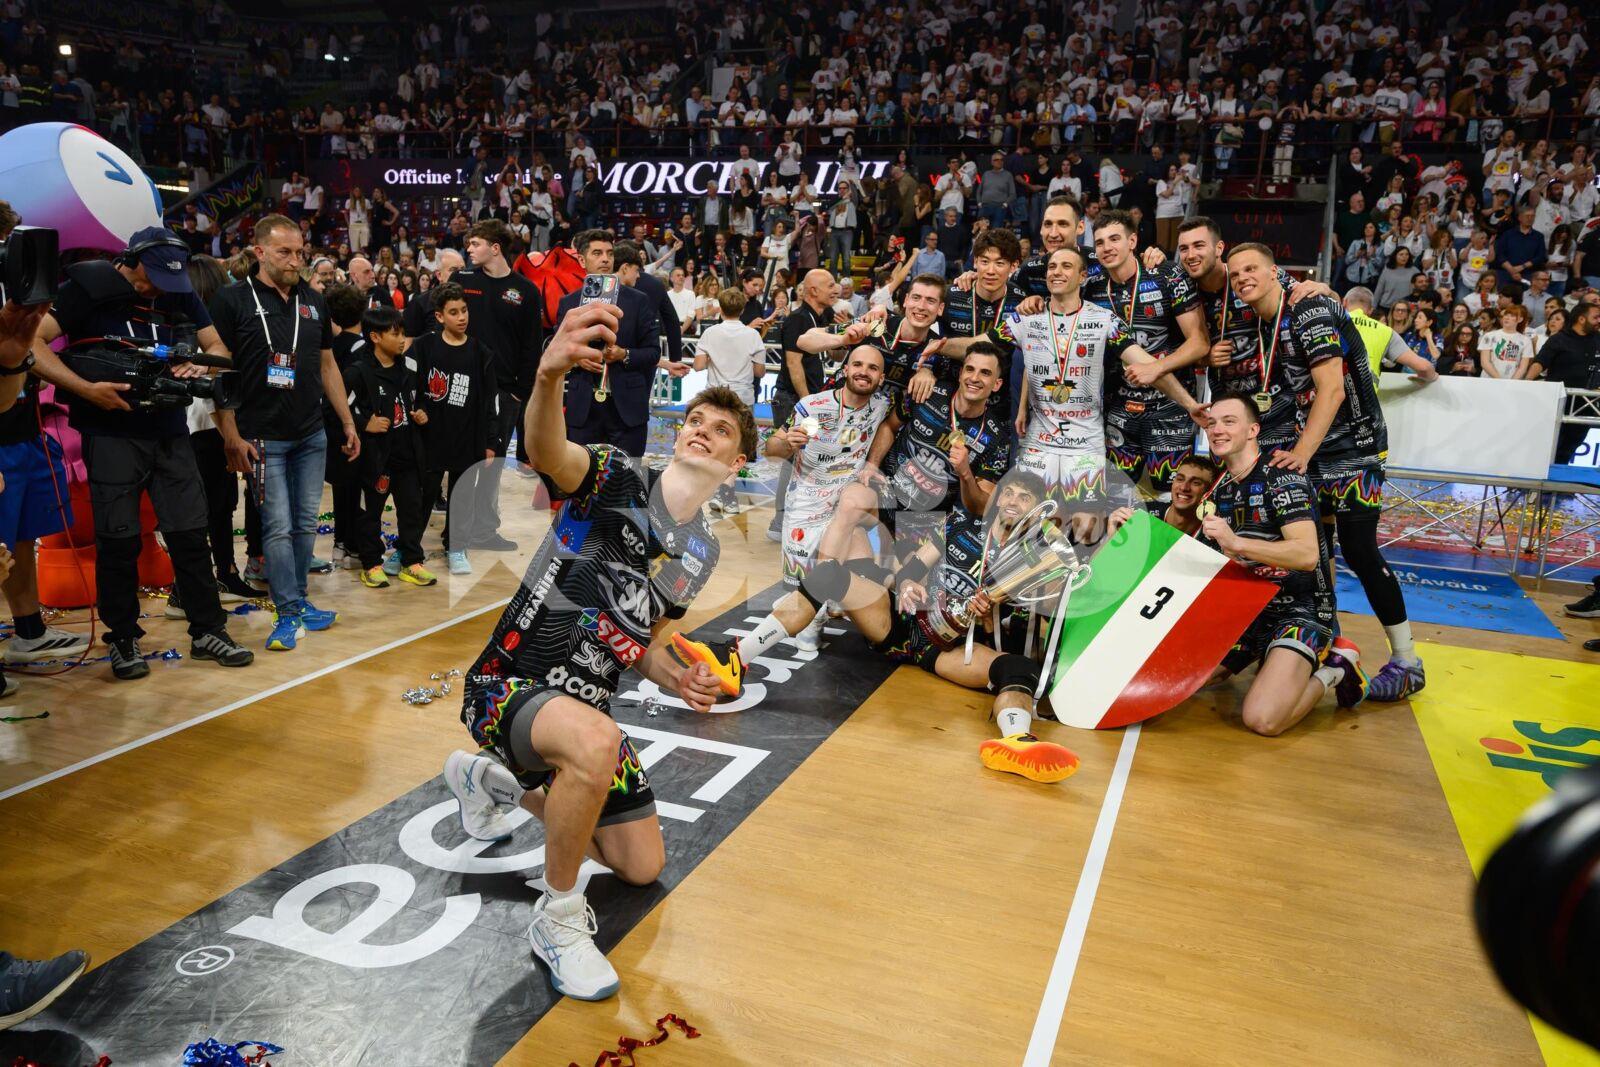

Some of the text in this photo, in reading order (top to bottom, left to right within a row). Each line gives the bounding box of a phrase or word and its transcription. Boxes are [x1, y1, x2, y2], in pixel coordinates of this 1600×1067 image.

[384, 168, 451, 185] Officine
[270, 368, 294, 378] STAFF
[452, 372, 470, 388] SIR
[1032, 365, 1091, 377] MON PETIT
[913, 419, 934, 437] OMO
[916, 447, 946, 475] SIR
[907, 464, 944, 497] SUSA
[1272, 491, 1292, 509] CSI
[621, 523, 646, 556] OMO
[519, 556, 563, 631] GRANIERI
[1140, 586, 1175, 620] 3
